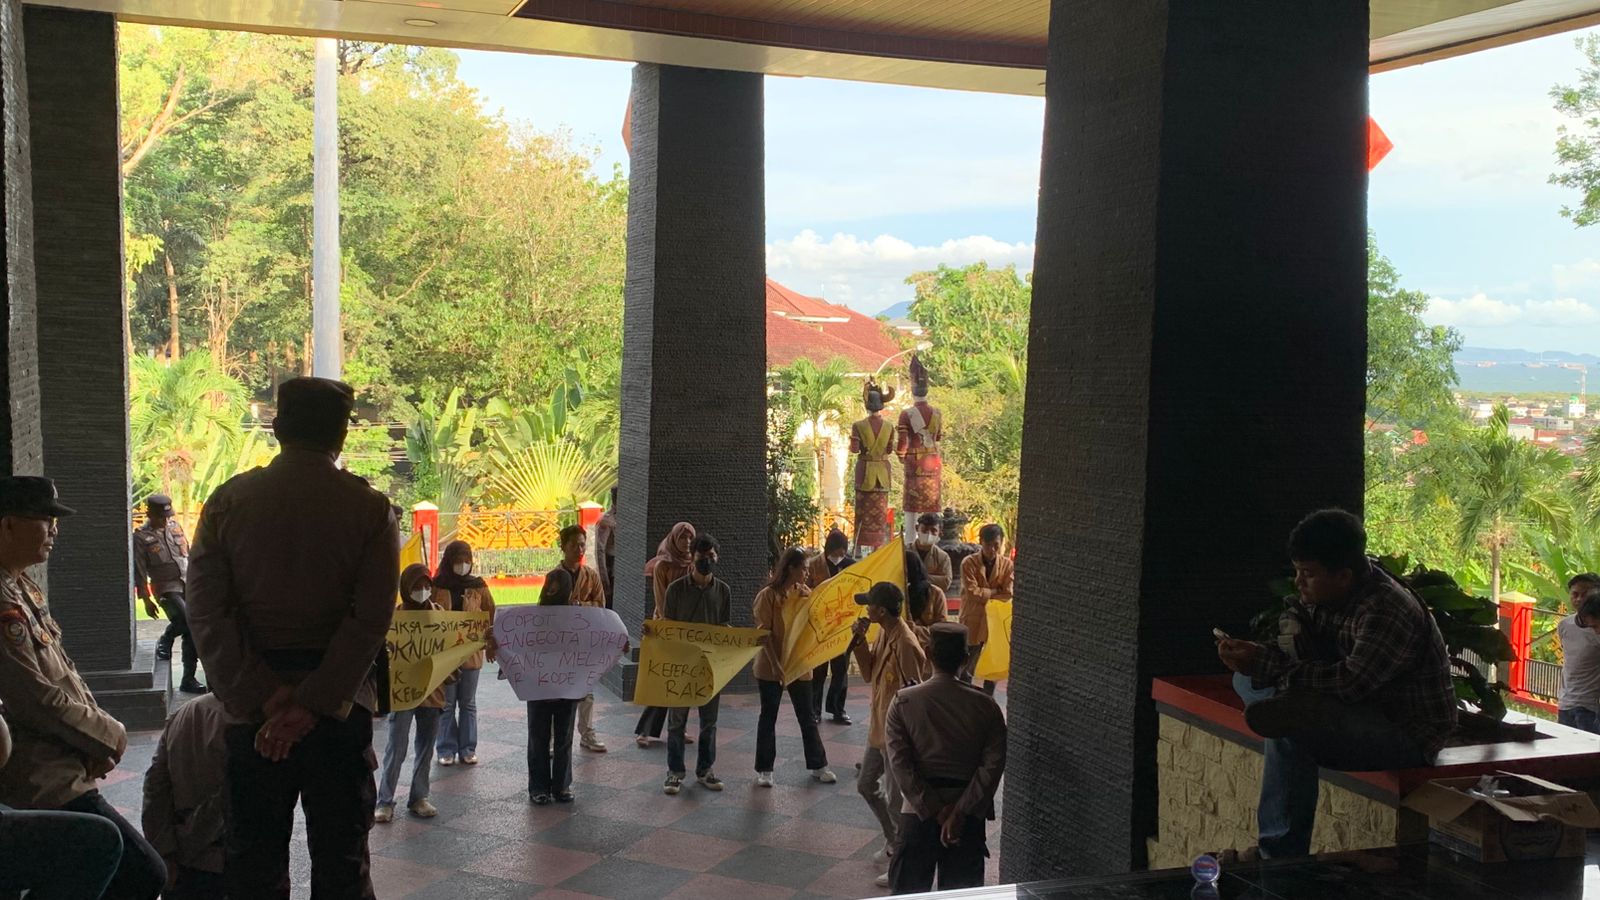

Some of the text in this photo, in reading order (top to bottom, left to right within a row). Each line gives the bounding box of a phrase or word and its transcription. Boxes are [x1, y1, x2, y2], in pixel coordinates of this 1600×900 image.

[389, 620, 422, 634] IKSA
[501, 612, 591, 633] COPOT 3
[499, 630, 580, 649] ANGGOTA
[654, 625, 741, 648] KETEGASAN
[500, 651, 547, 672] YANG
[537, 671, 577, 687] KODE
[666, 679, 714, 700] RAK
